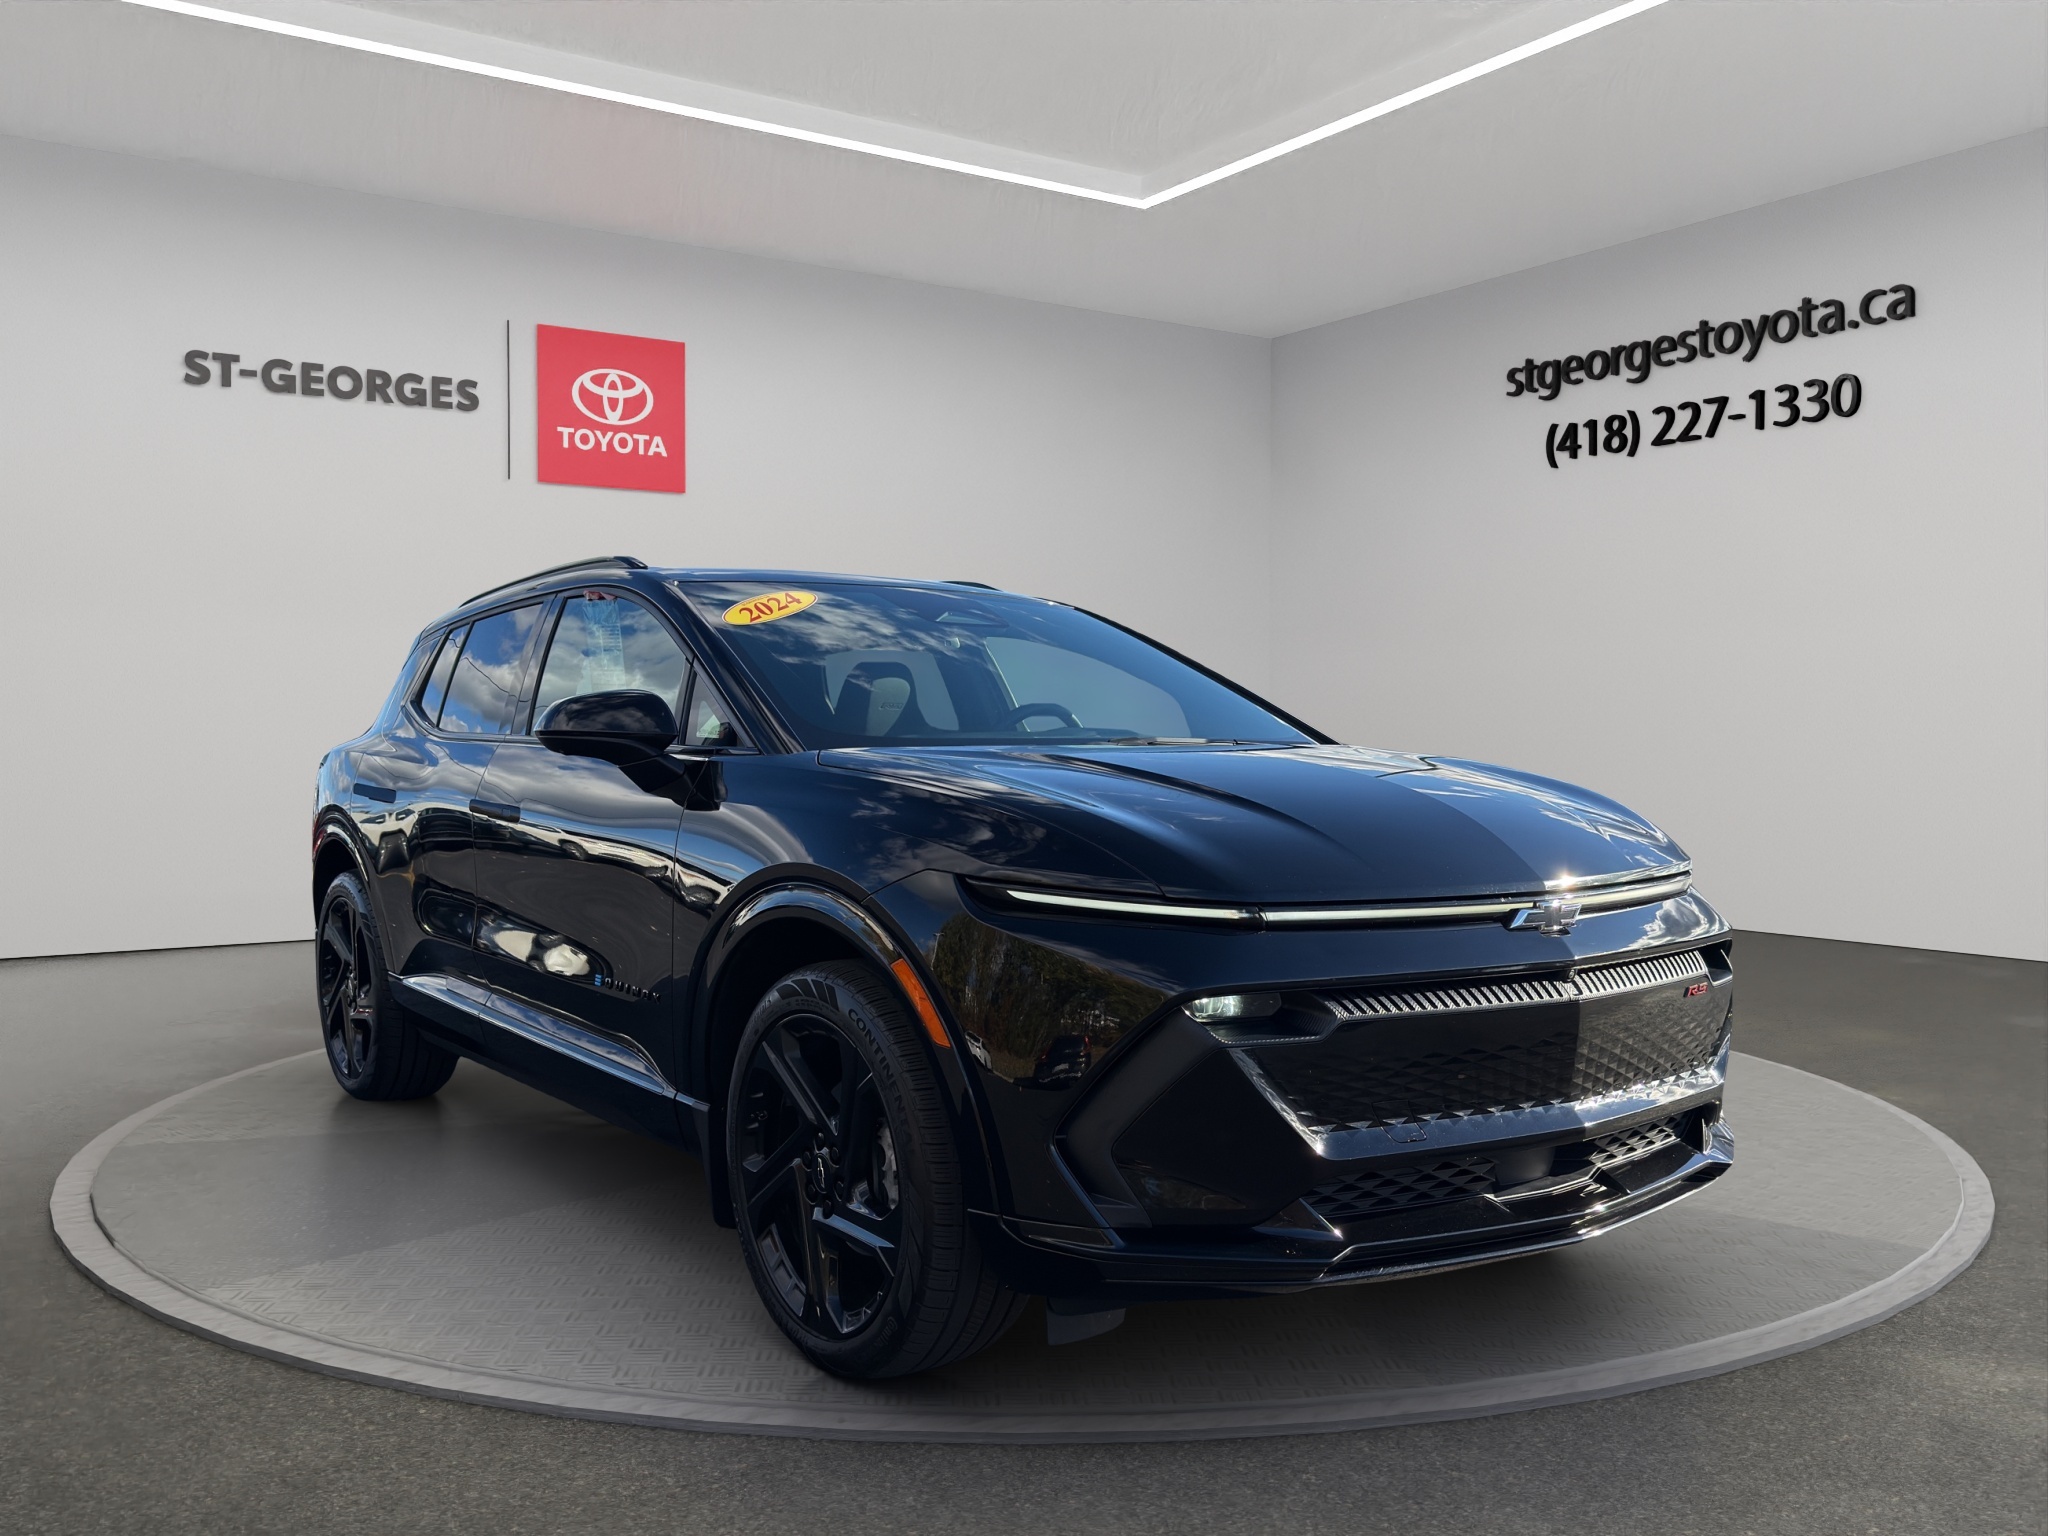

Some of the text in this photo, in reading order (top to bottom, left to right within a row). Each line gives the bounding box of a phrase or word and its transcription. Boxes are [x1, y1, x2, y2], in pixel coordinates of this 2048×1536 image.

[1506, 283, 1917, 401] stgeorgestoyota.ca
[183, 349, 481, 412] ST-GEORGES
[556, 426, 668, 457] TOYOTA
[1545, 373, 1863, 469] (418) 227-1330
[739, 592, 802, 622] 2024
[1687, 982, 1709, 997] RS
